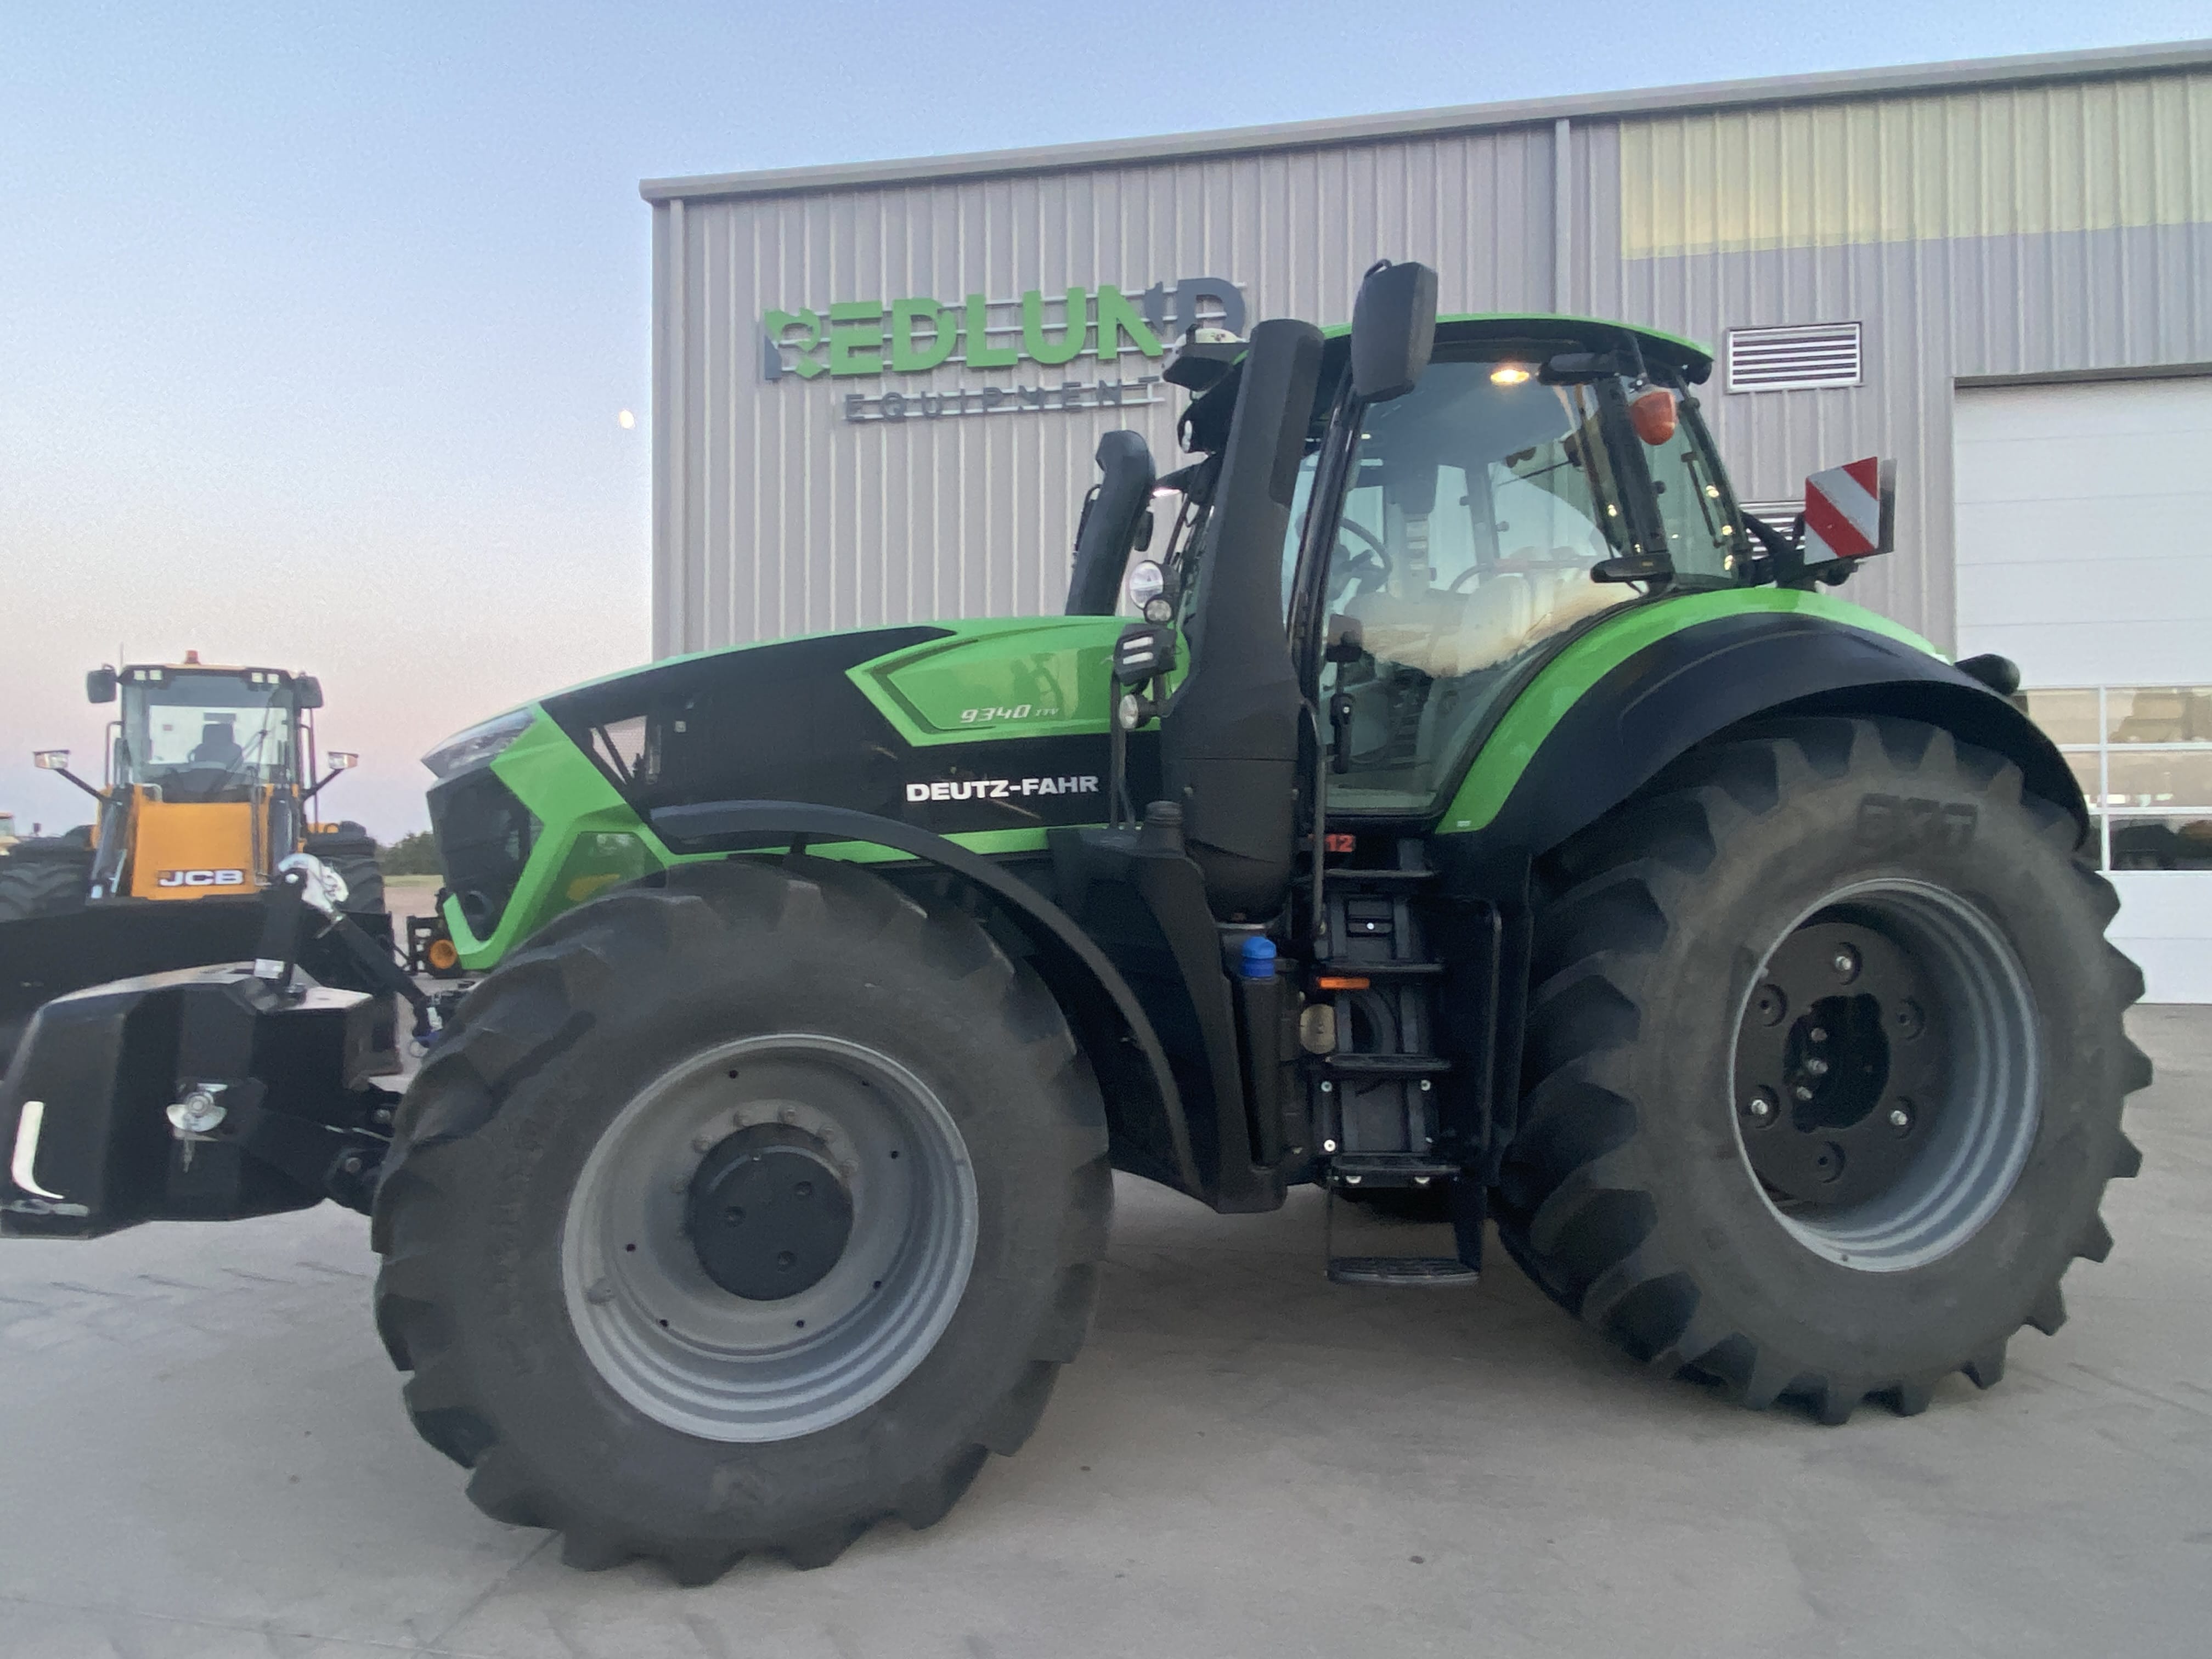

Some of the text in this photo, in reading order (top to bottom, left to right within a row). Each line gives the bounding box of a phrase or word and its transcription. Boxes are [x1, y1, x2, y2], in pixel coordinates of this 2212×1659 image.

[764, 276, 1245, 380] REDLUND
[845, 375, 1160, 421] EQUIPMENT
[960, 704, 1033, 724] 9340
[906, 775, 1098, 802] DEUTZ-FAHR
[159, 870, 244, 886] JCB
